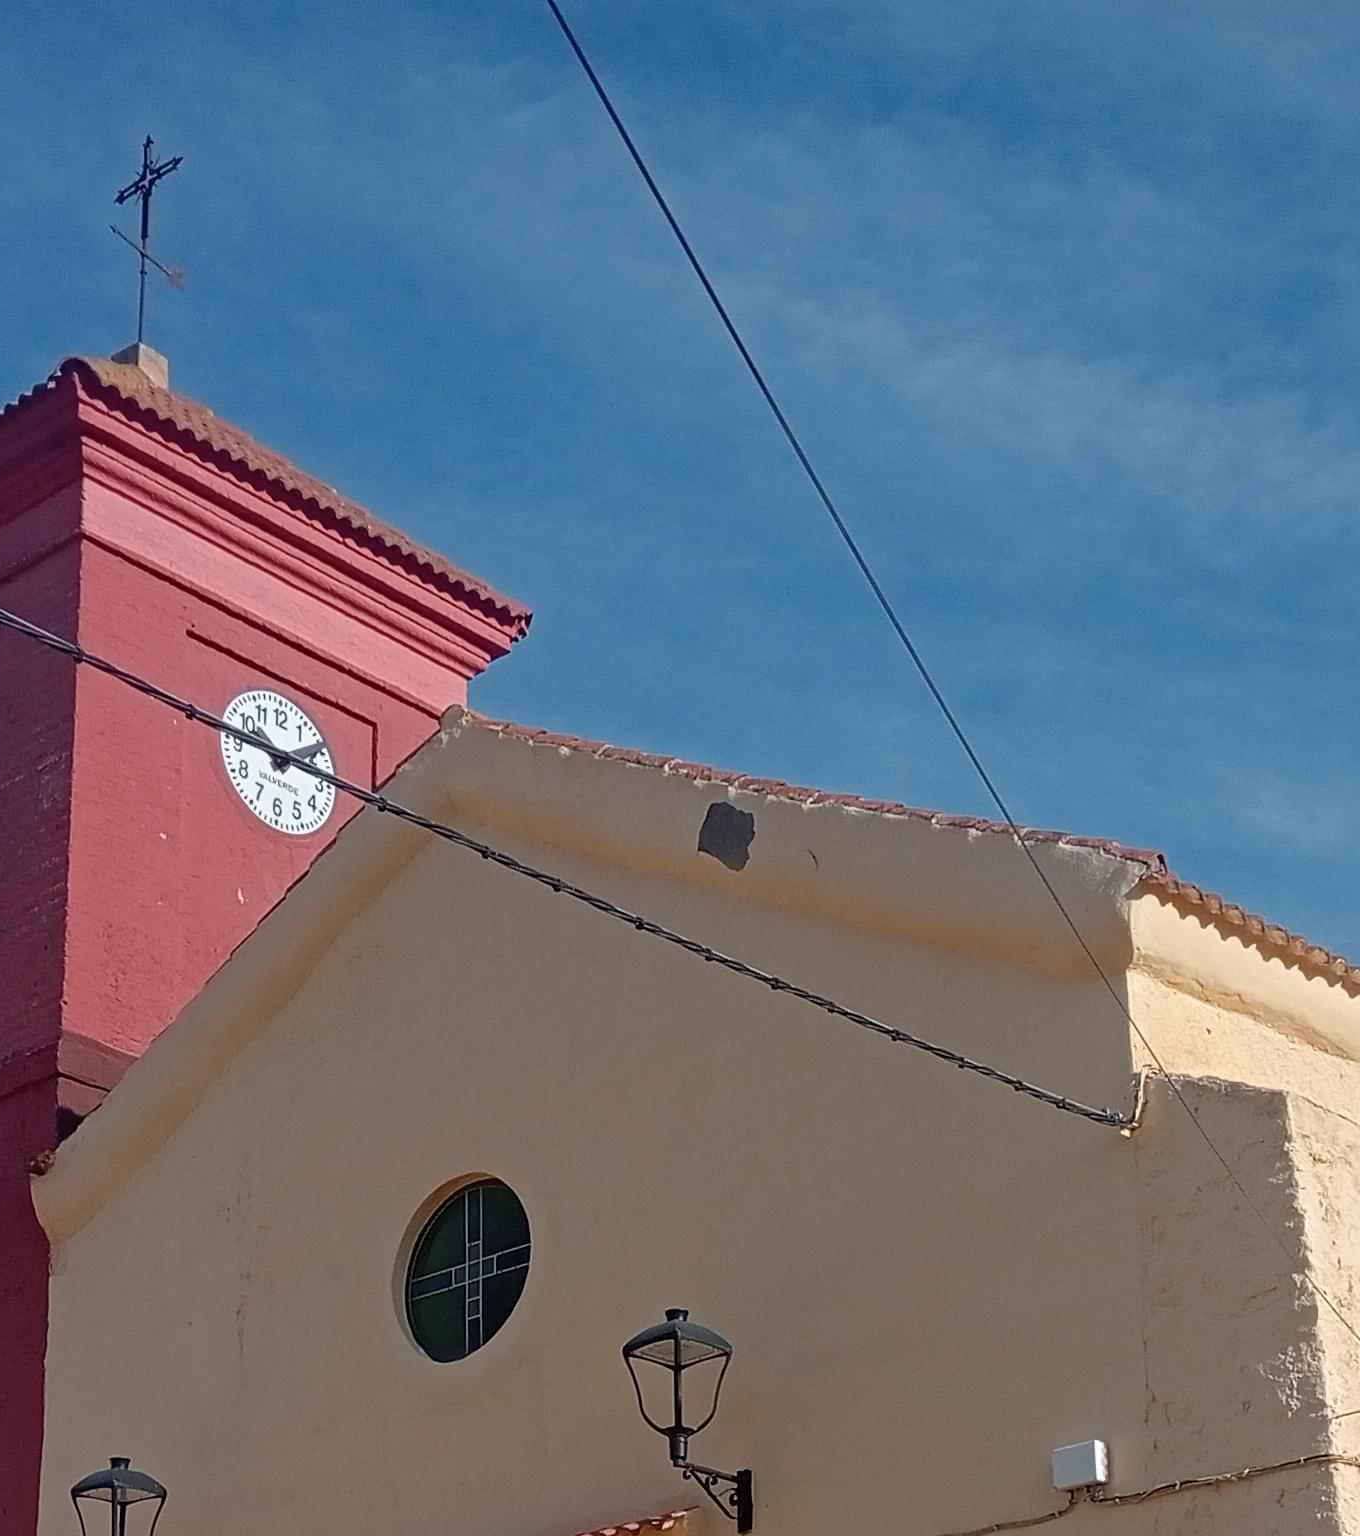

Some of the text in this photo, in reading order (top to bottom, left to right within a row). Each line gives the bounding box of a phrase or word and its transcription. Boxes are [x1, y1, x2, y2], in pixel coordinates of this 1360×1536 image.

[239, 712, 256, 734] 10
[255, 704, 267, 726] 11
[273, 707, 288, 731] 12
[296, 724, 302, 742] 1
[238, 759, 249, 779] 8
[255, 781, 264, 802] 7
[258, 770, 300, 796] VALVERDE
[272, 798, 283, 818] 6
[292, 801, 302, 820] 5
[307, 794, 318, 813] 4
